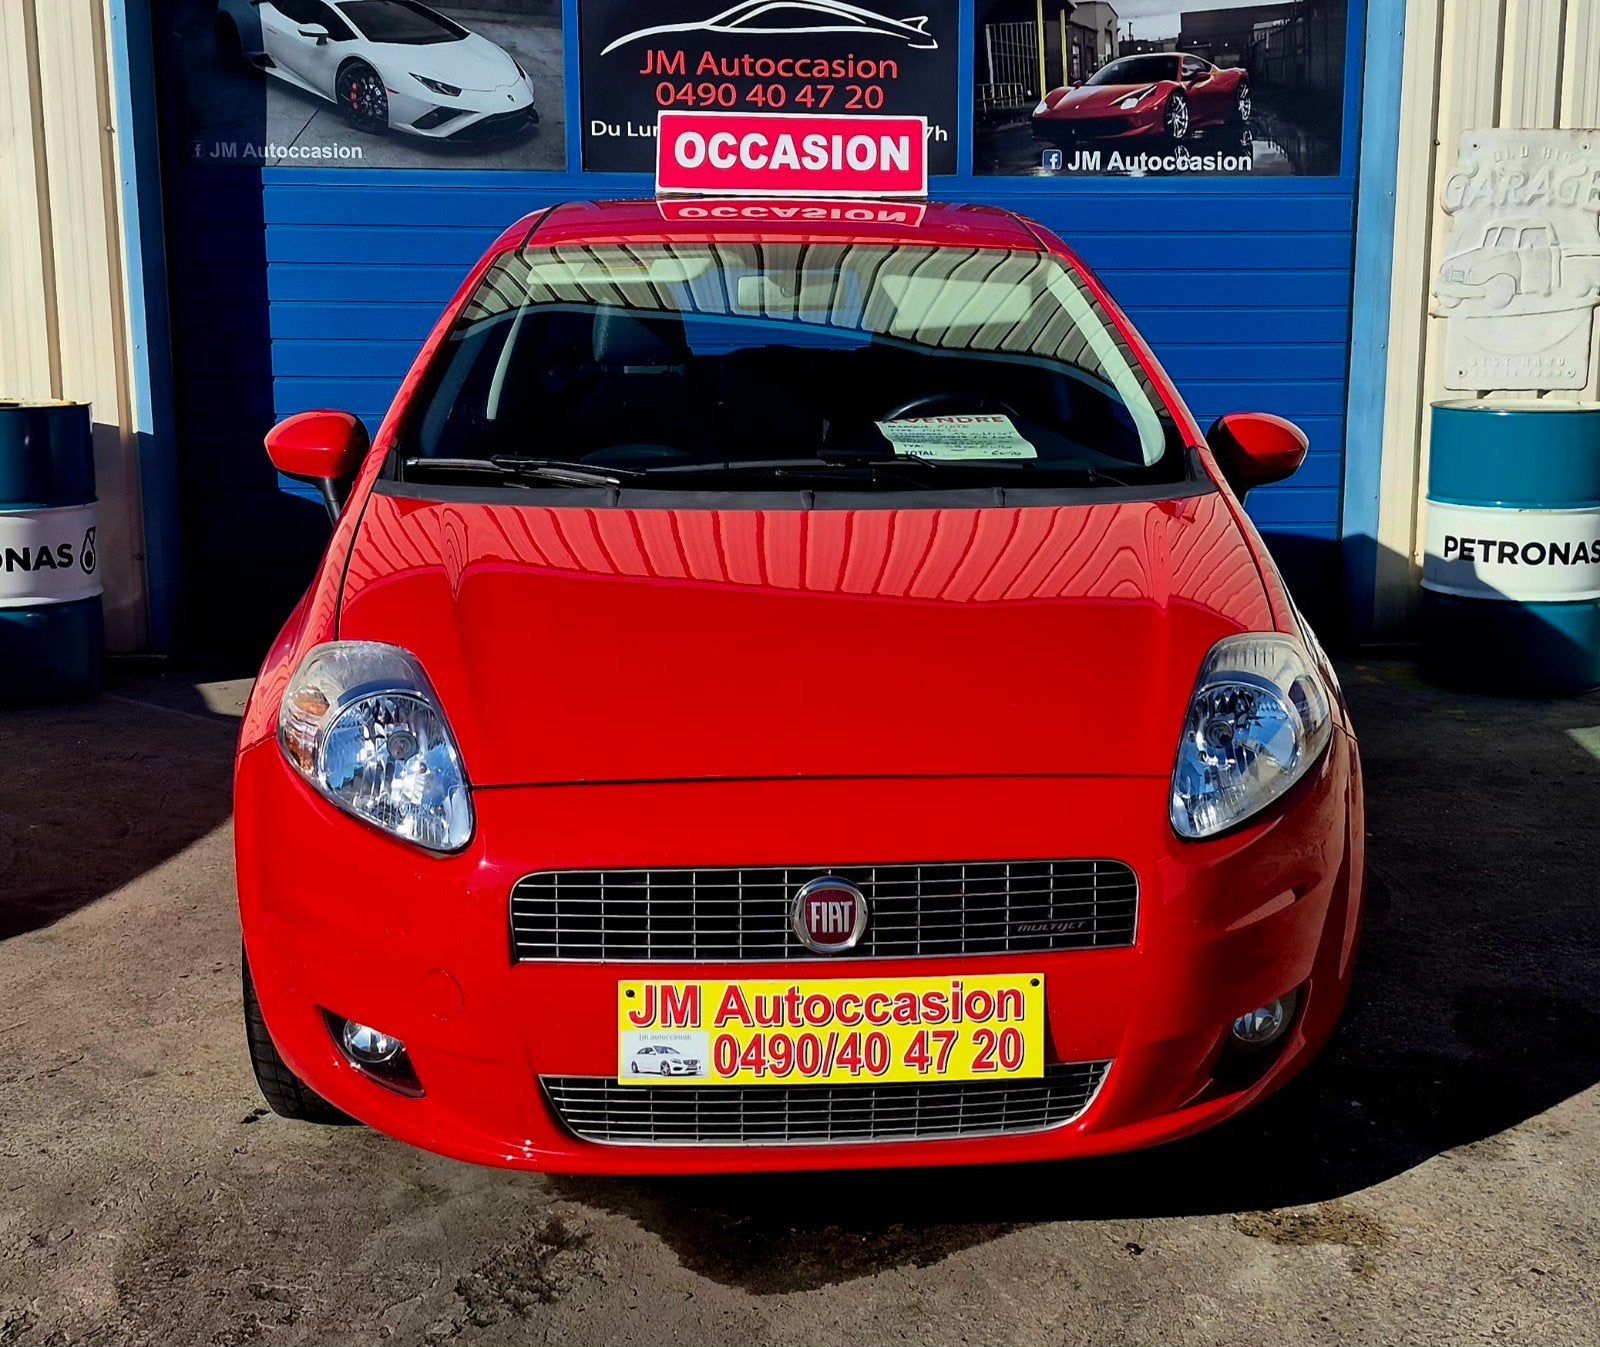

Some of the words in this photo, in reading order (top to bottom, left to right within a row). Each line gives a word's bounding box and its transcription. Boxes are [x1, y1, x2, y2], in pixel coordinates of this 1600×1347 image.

[640, 50, 686, 75] JM
[696, 50, 898, 79] Autoccasion
[656, 82, 737, 107] 0490
[745, 84, 786, 108] 40
[795, 85, 834, 109] 47
[844, 86, 884, 109] 20
[591, 120, 620, 137] Du
[210, 142, 237, 158] JM
[243, 142, 363, 159] Autoccasion
[674, 131, 910, 171] OCCASION
[1067, 151, 1101, 171] JM
[1106, 150, 1252, 171] Autoccasion
[904, 416, 1005, 425] VENDRE
[810, 901, 854, 933] FIAT
[629, 984, 702, 1028] JM
[714, 980, 1025, 1028] Autoccasion
[714, 1030, 891, 1078] 0490/40
[903, 1029, 958, 1076] 47
[971, 1027, 1025, 1072] 20
